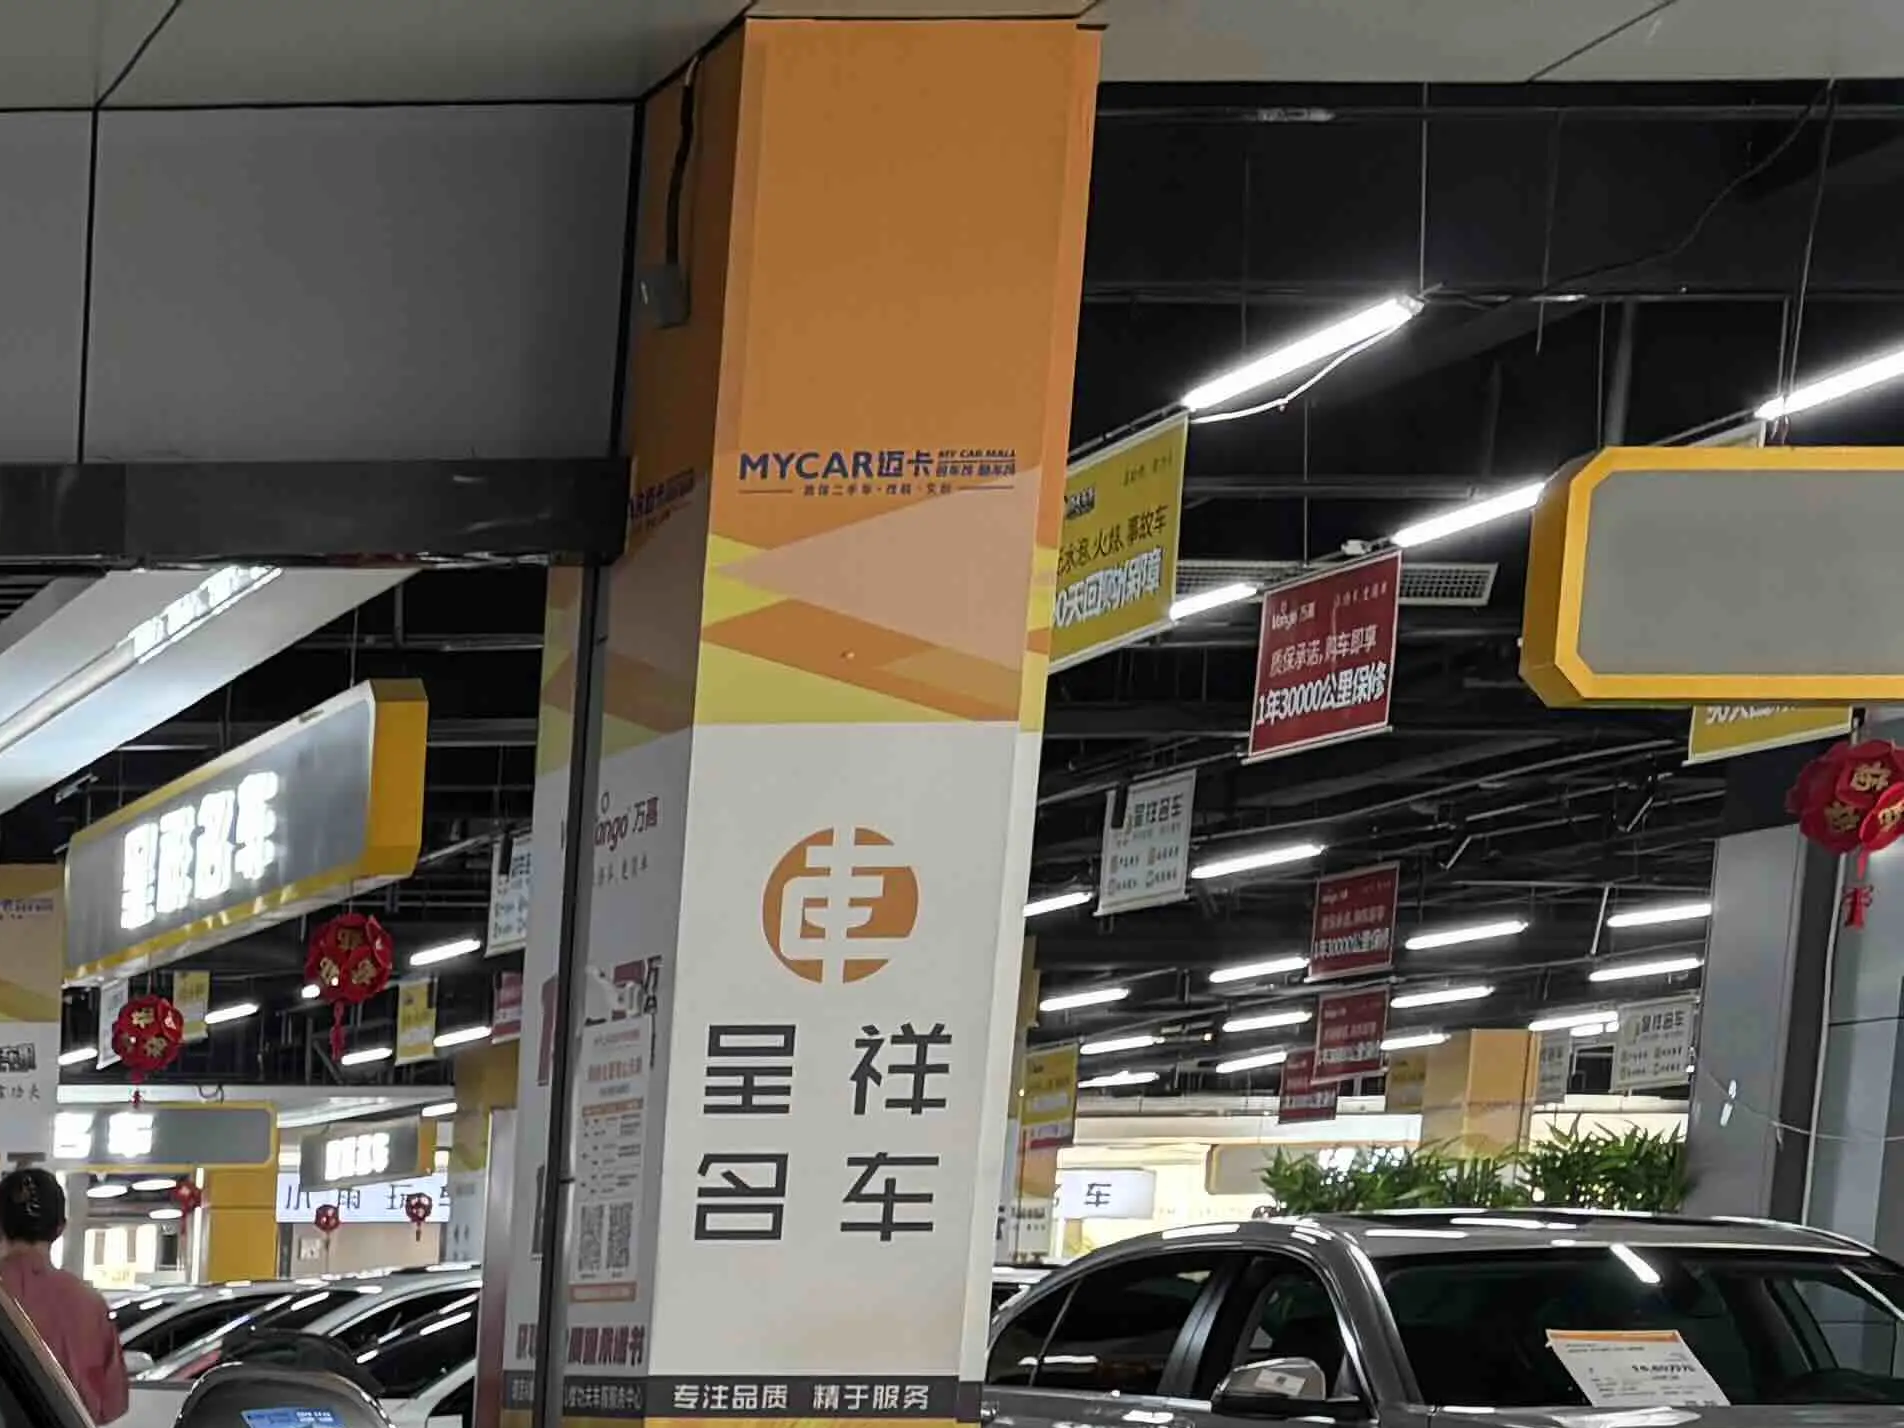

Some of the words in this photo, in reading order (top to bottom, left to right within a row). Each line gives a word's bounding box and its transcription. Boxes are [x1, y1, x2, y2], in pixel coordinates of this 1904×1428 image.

[1255, 660, 1388, 726] 1年30000公里保修
[672, 1383, 789, 1410] 专注品质
[812, 1382, 931, 1410] 精于服务
